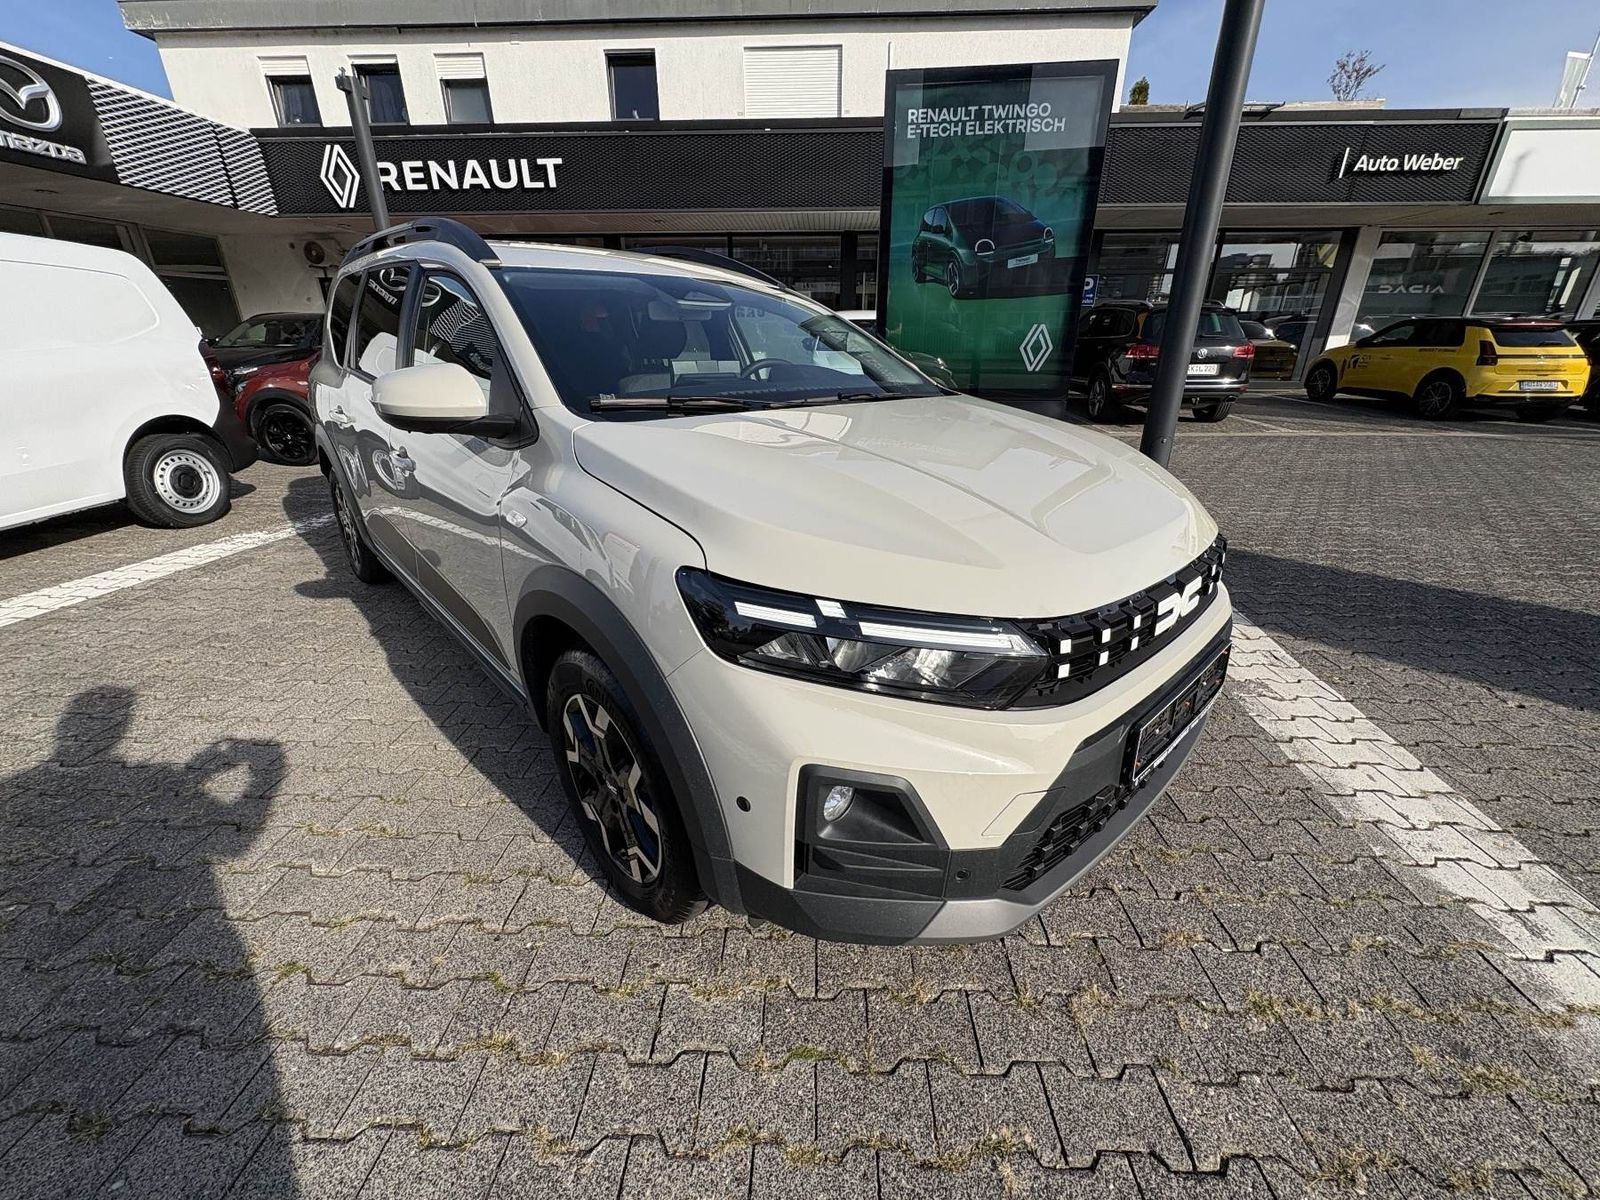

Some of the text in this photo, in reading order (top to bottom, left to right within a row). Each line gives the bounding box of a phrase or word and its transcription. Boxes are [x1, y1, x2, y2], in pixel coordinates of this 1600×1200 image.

[907, 102, 1051, 124] RENAULT TWINGO
[906, 117, 1066, 139] E-TECH ELEKTRISCH
[1353, 152, 1464, 172] Auto Weber
[376, 157, 563, 191] RENAULT
[1378, 284, 1446, 294] DACIA
